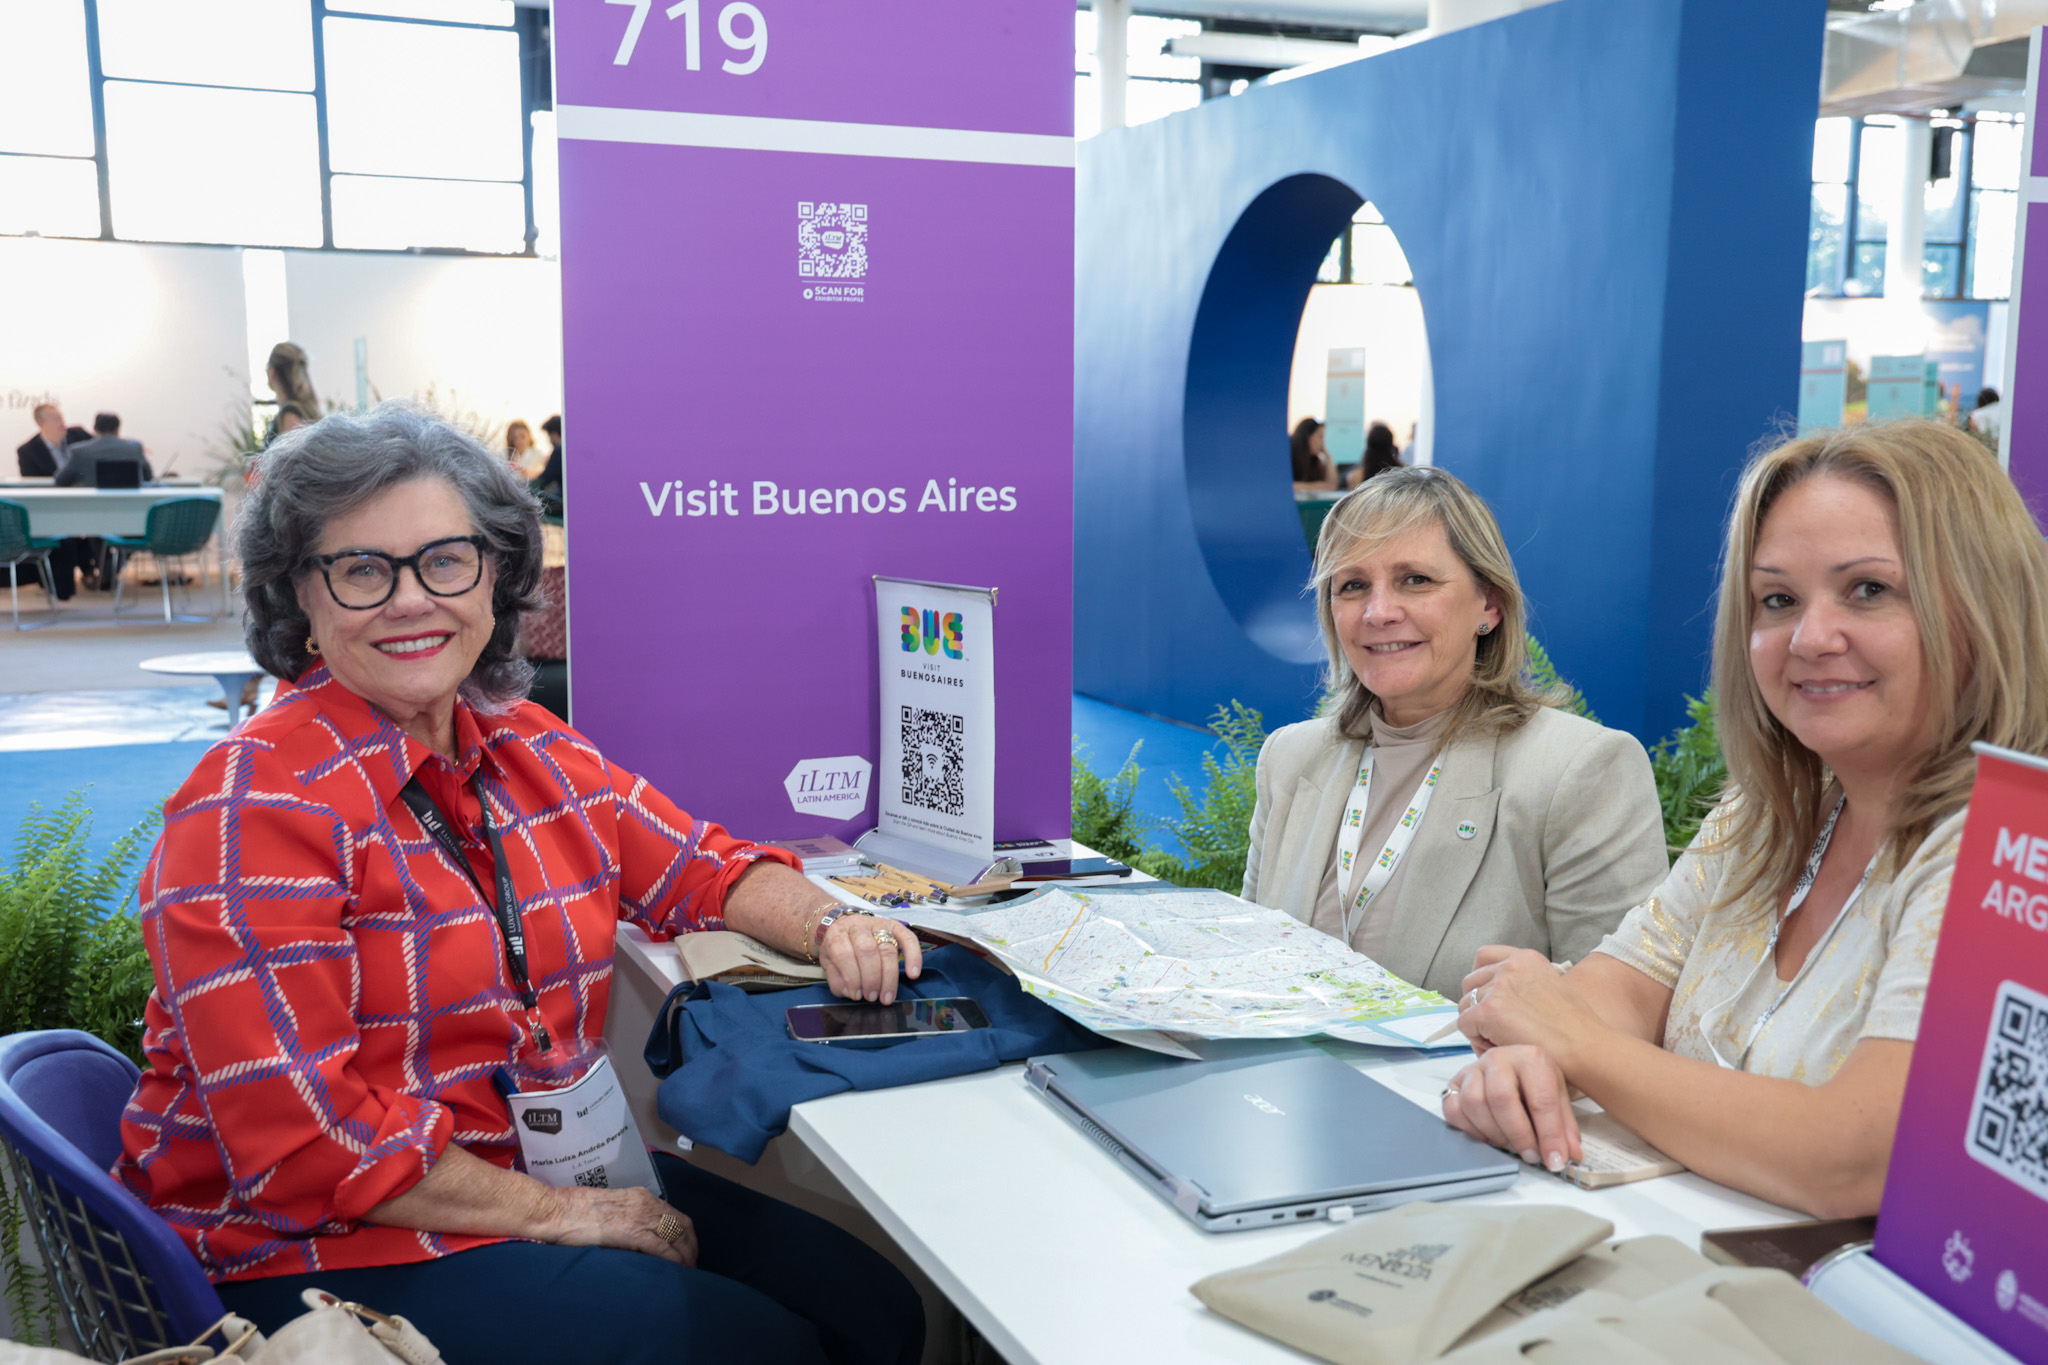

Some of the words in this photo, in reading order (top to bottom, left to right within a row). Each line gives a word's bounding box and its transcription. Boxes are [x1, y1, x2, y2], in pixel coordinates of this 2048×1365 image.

[604, 0, 769, 76] 719
[815, 286, 842, 296] SCAN
[844, 287, 864, 296] FOR
[639, 480, 739, 517] Visit
[752, 480, 907, 515] Buenos
[917, 477, 1017, 512] Aires
[901, 606, 963, 660] BUE
[901, 669, 964, 688] BUENOSAIRES
[922, 663, 940, 672] VISIT
[798, 769, 863, 792] ILTM
[797, 794, 822, 804] LATIN
[823, 792, 860, 802] AMERICA
[1993, 827, 2048, 883] ME
[502, 876, 512, 903] GROUP
[1981, 879, 2048, 932] ARG
[506, 904, 516, 933] LUXURY
[528, 1112, 558, 1123] ILTM
[606, 1125, 628, 1144] Pereira
[584, 1156, 600, 1164] Tours
